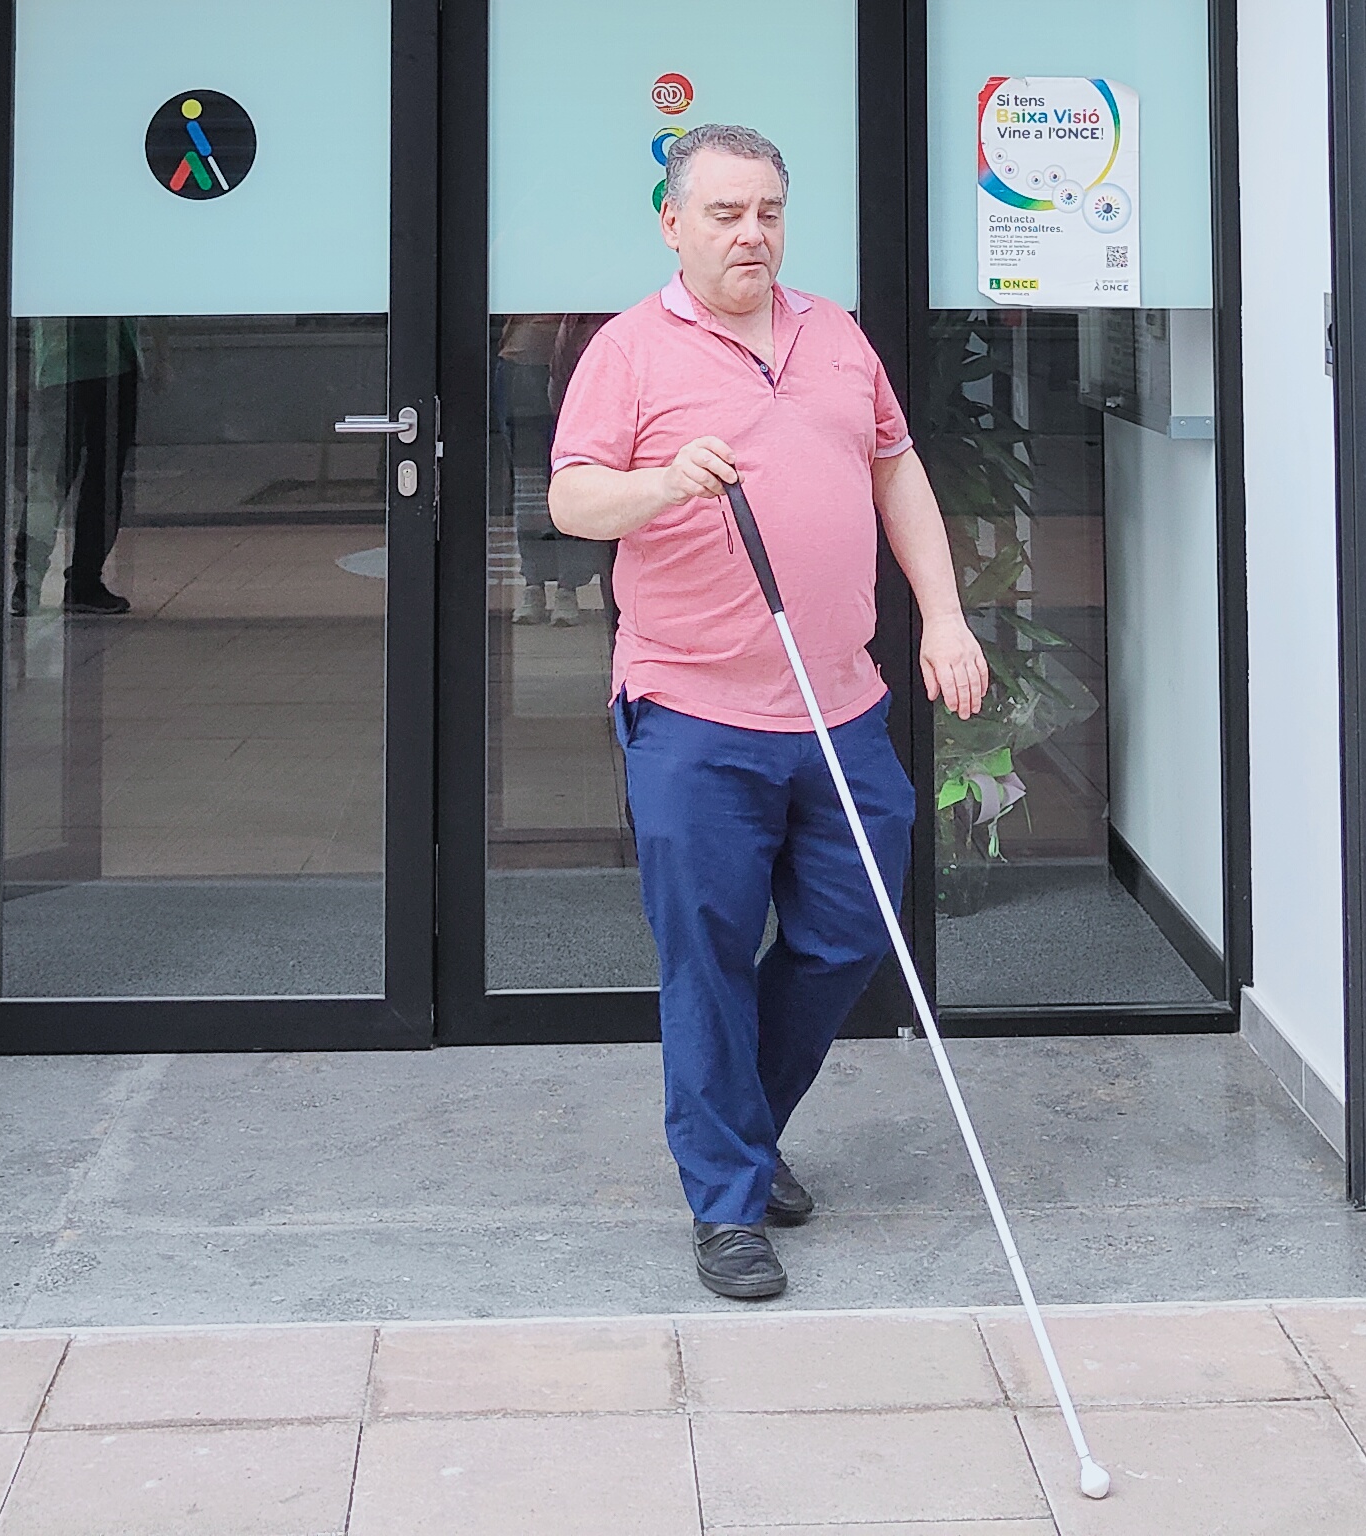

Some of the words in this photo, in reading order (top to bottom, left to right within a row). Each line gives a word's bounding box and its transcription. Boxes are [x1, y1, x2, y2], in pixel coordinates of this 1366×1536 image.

[996, 94, 1010, 106] Si
[1014, 95, 1045, 106] tens
[996, 109, 1048, 124] Baixa
[1054, 109, 1100, 124] Visió
[996, 126, 1030, 139] Vine
[1034, 130, 1043, 139] a
[989, 215, 1035, 223] Contacta
[988, 224, 1011, 233] amb
[1014, 224, 1064, 233] nosaltres.
[1003, 280, 1037, 289] ONCE
[1102, 284, 1129, 292] ONCE
